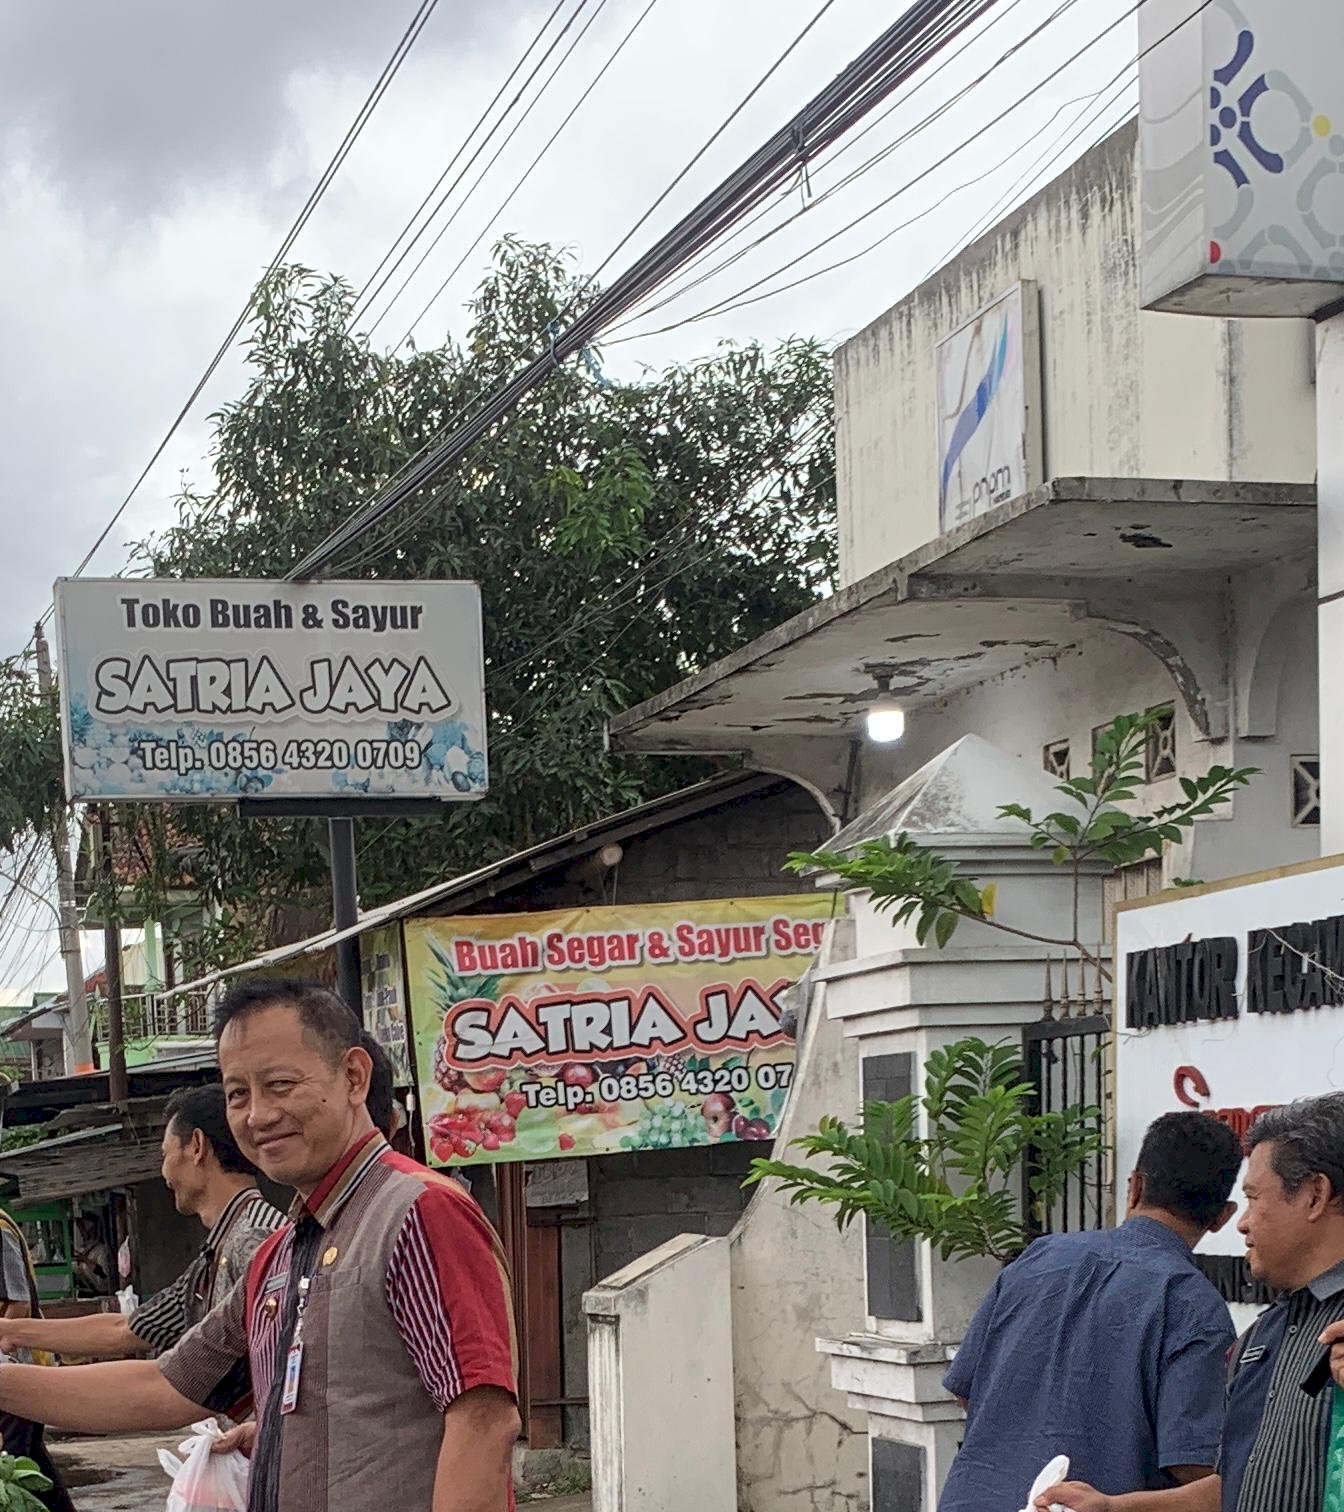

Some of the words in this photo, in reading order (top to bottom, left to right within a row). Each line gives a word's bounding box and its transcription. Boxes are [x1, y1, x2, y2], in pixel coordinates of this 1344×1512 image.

[121, 598, 201, 629] Toko
[210, 598, 293, 629] Buah
[301, 600, 323, 629] &
[331, 599, 423, 632] Sayur
[95, 655, 296, 715] SATRIA
[300, 655, 451, 714] JAYA
[139, 741, 202, 776] Telp.
[208, 741, 277, 770] 0856
[282, 741, 349, 770] 4320
[357, 740, 422, 770] 0709
[455, 938, 539, 973] Buah
[546, 932, 640, 967] Segar
[648, 932, 670, 960] &
[675, 924, 766, 958] Sayur
[1126, 936, 1239, 1030] KANTOR
[454, 990, 686, 1062] SATRIA
[694, 986, 794, 1046] JA
[521, 1082, 594, 1110] Telp.
[599, 1073, 674, 1102] 0856
[681, 1067, 750, 1095] 4320
[757, 1063, 794, 1090] 07
